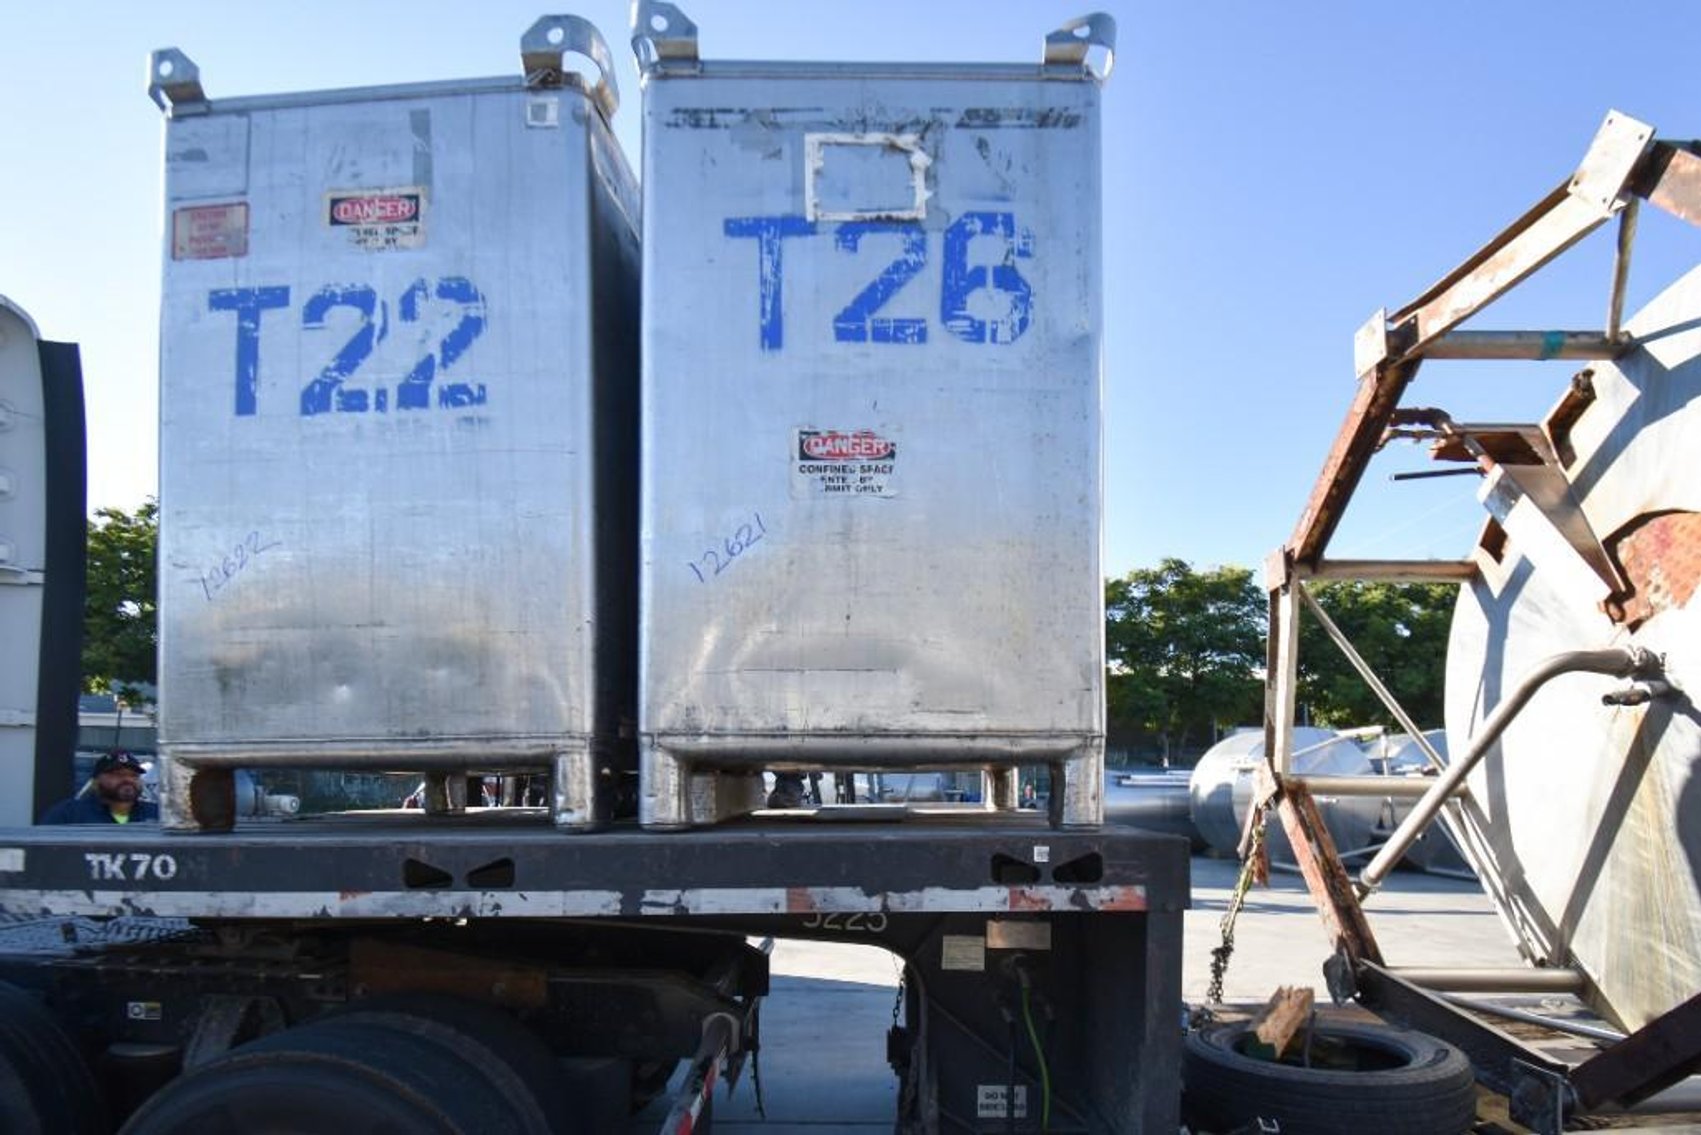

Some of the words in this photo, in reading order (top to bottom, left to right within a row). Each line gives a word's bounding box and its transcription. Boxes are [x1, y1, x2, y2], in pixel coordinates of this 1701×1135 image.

[724, 211, 1036, 352] T26
[208, 276, 488, 416] T22
[810, 438, 885, 454] DANGER
[688, 512, 766, 583] 12621
